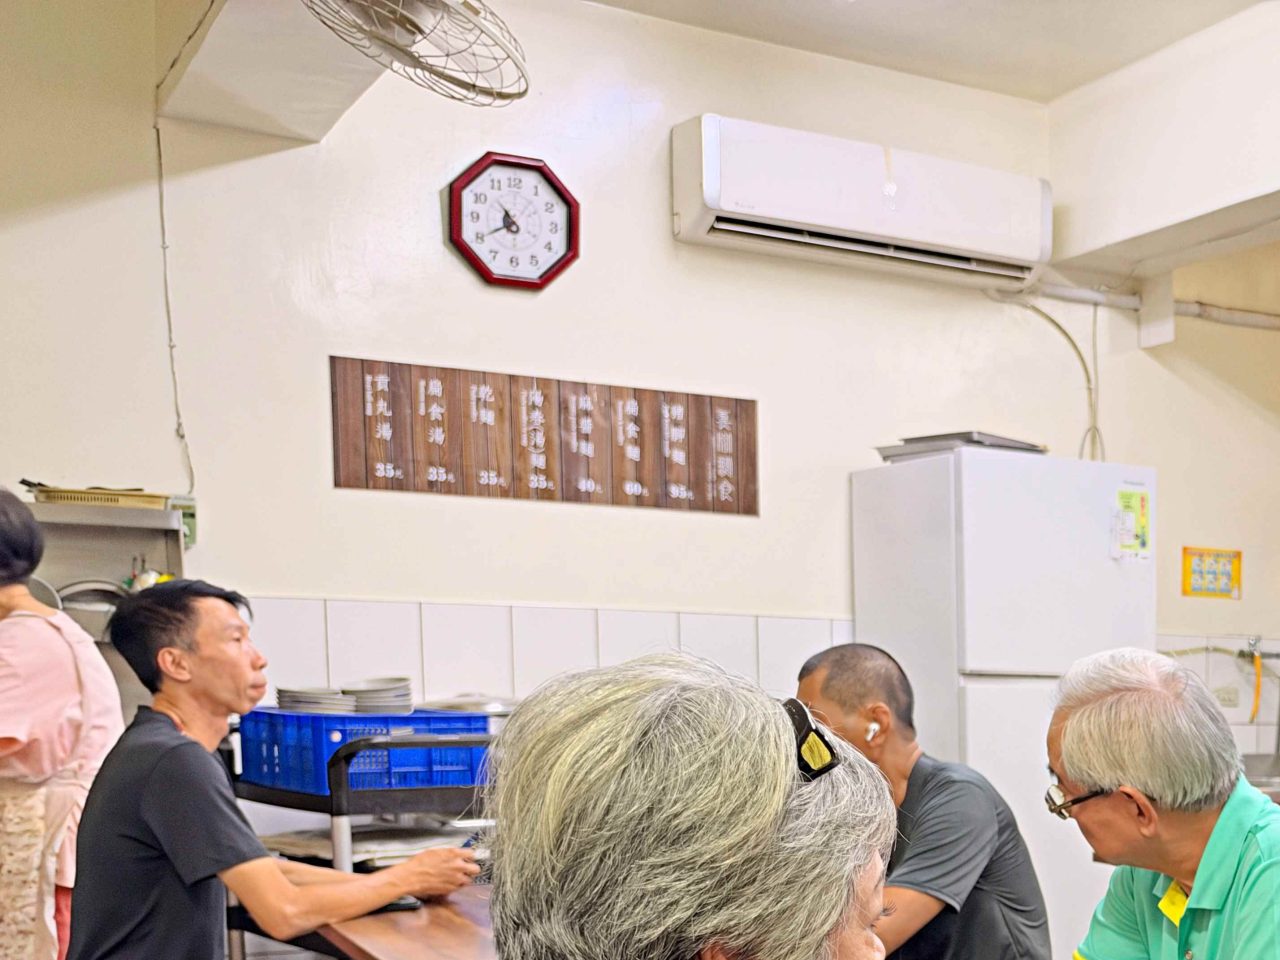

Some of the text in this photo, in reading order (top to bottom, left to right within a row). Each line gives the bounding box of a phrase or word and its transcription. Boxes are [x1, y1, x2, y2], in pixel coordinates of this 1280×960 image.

[490, 178, 502, 191] 11
[507, 177, 523, 189] 12
[474, 193, 487, 204] 10
